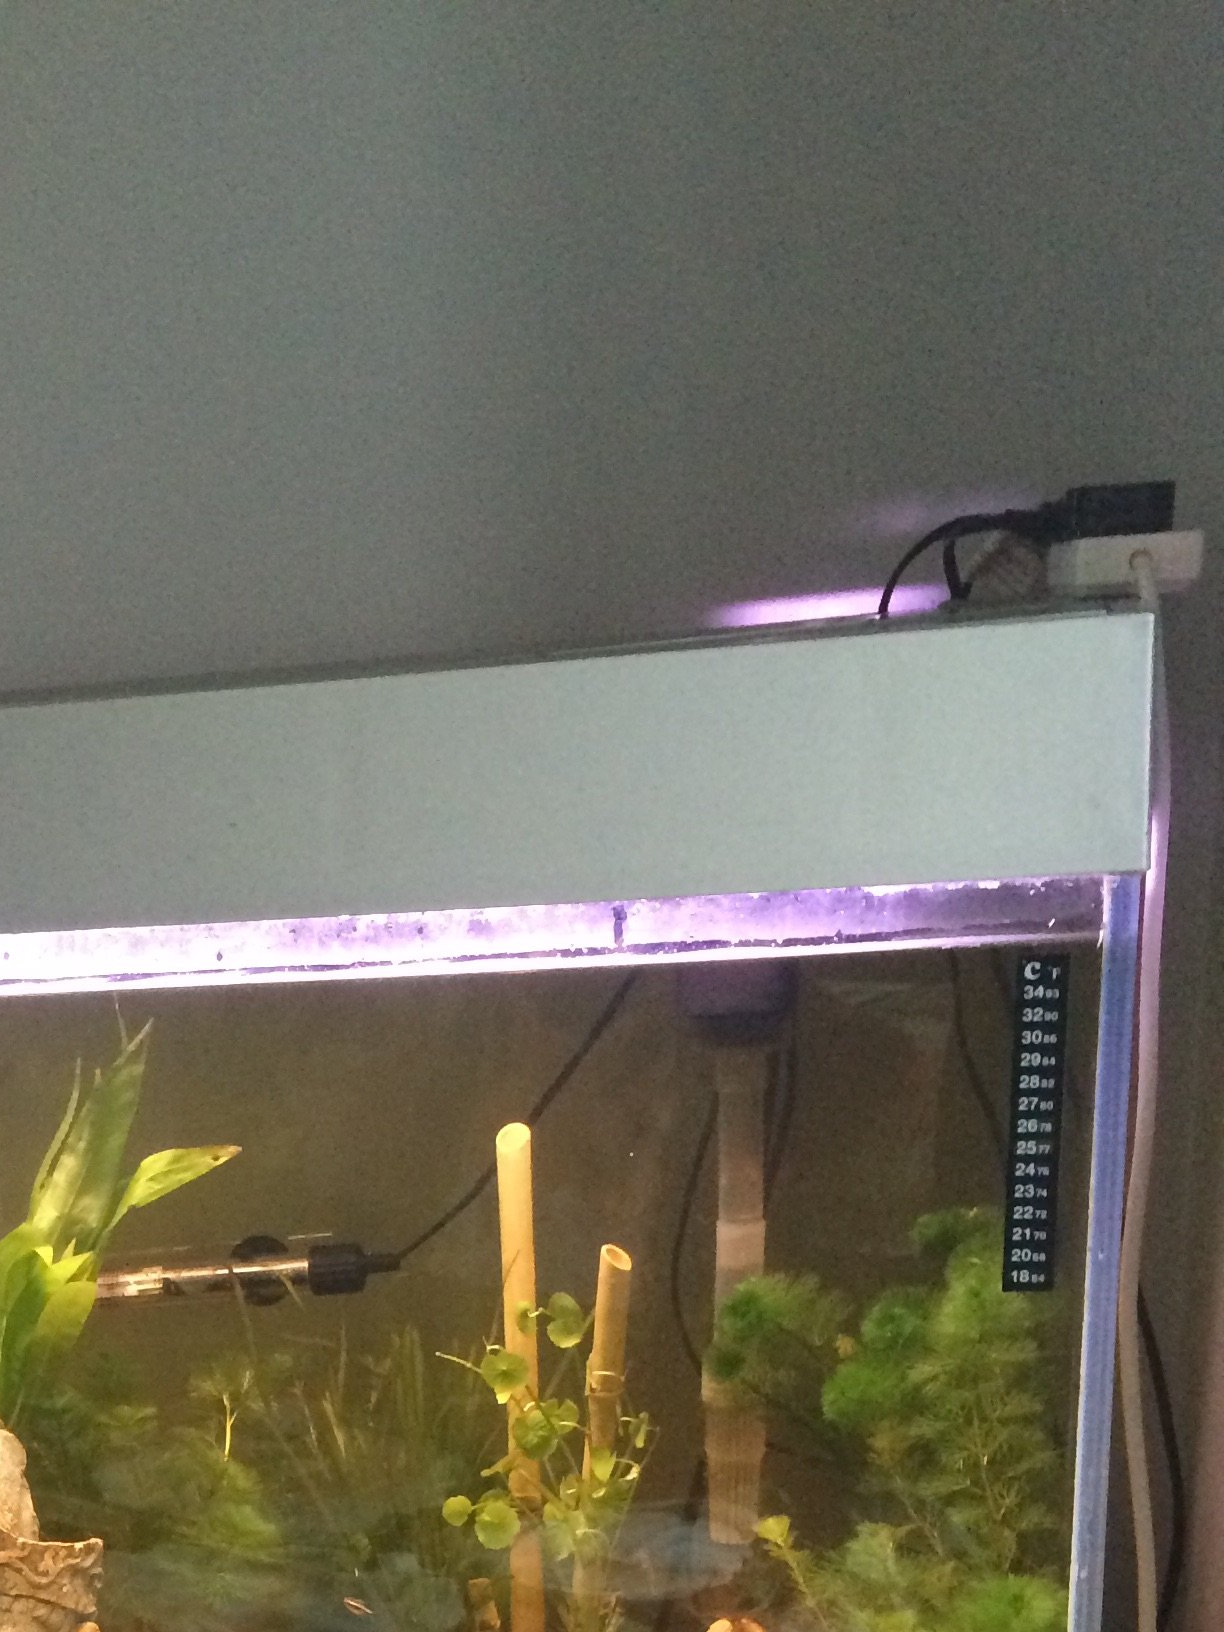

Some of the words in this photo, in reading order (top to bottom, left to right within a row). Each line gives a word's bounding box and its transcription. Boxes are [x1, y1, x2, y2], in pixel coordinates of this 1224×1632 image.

[1023, 985, 1044, 1000] 34
[1022, 1007, 1044, 1022] 32
[1021, 1030, 1042, 1044] 30
[1019, 1074, 1040, 1089] 28
[1018, 1096, 1038, 1111] 27
[1016, 1140, 1036, 1155] 25
[1015, 1162, 1035, 1177] 24
[1014, 1184, 1034, 1198] 23
[1013, 1205, 1034, 1219] 22
[1012, 1227, 1031, 1241] 21
[1011, 1248, 1032, 1262] 20
[1011, 1269, 1030, 1283] 18
